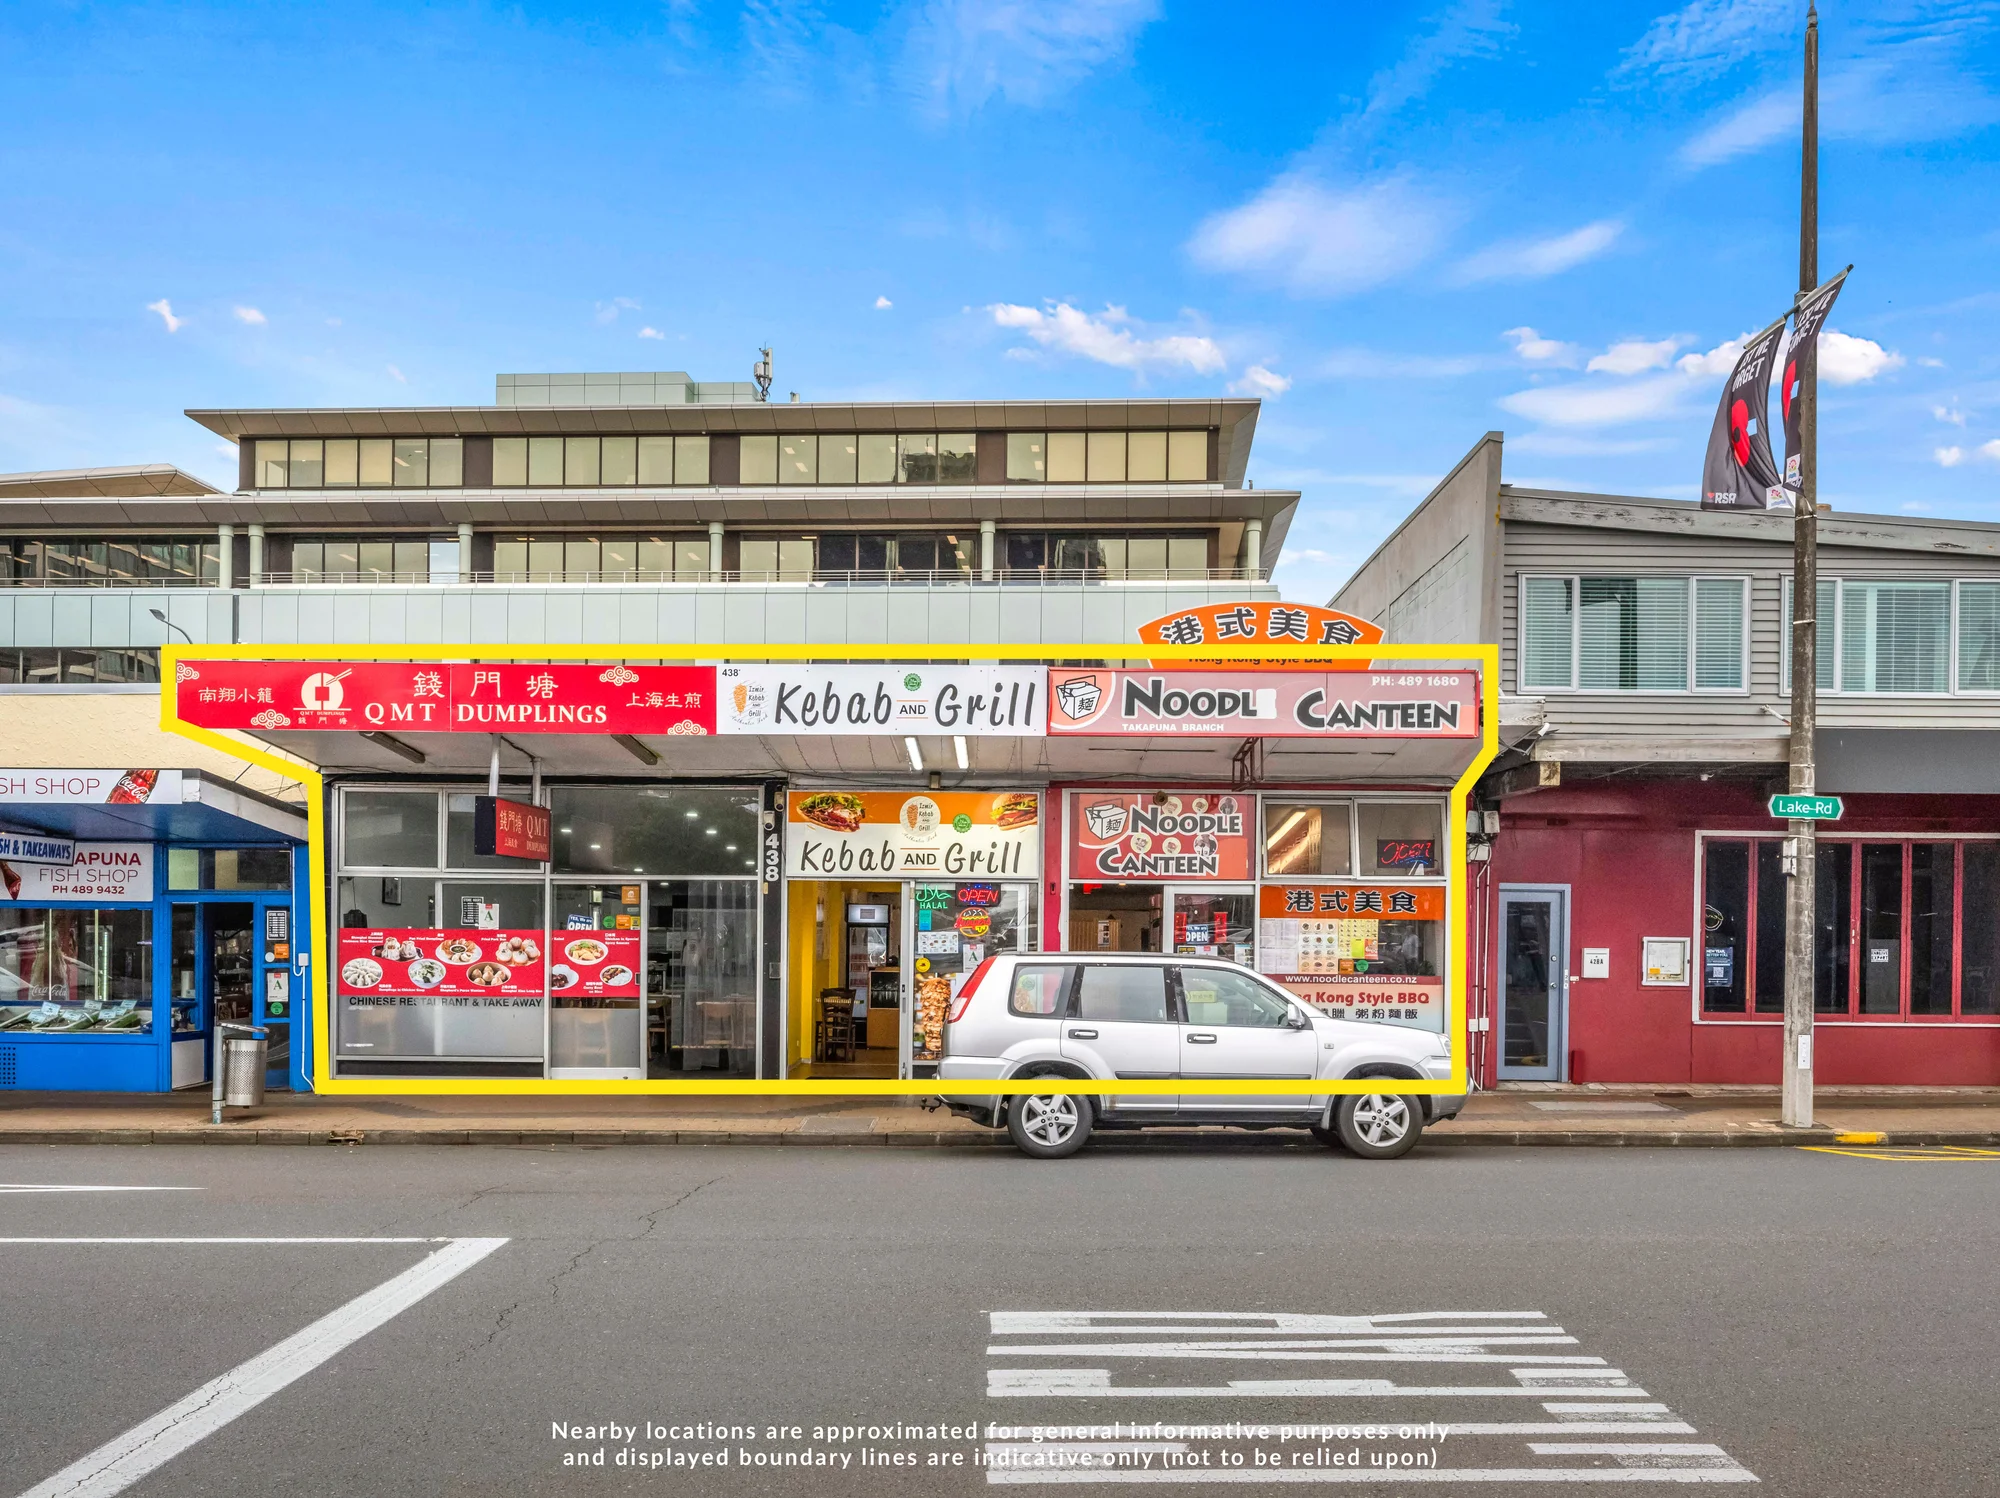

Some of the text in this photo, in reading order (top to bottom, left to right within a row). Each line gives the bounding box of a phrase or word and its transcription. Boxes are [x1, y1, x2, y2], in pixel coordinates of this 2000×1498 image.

[1714, 492, 1737, 504] RSA
[413, 670, 559, 699] 錢門塘
[1372, 676, 1460, 687] PH: 489 1680
[626, 692, 702, 709] 上海生煎
[774, 681, 1036, 727] Kebab AND Grill
[365, 702, 607, 725] QMT DUMPLINGS
[1296, 690, 1459, 730] CANTEEN
[1122, 723, 1224, 732] TAKAPUNA BRANCH
[35, 778, 101, 795] SHOP
[1779, 800, 1833, 815] Lake Rd
[526, 815, 548, 839] QMT
[1130, 806, 1241, 834] NOODLE
[13, 840, 20, 856] &
[22, 841, 72, 860] TAKEAWAYS
[800, 840, 1022, 874] Kebab AND Grill
[765, 833, 780, 883] 438
[1098, 847, 1217, 874] CANTEEN
[39, 868, 139, 883] FISH SHOP
[52, 885, 125, 895] PH 489 9432
[957, 888, 999, 903] OPEN
[919, 901, 948, 909] HALAL
[1285, 889, 1417, 913] 港式美食
[484, 910, 494, 921] A
[1186, 932, 1208, 942] OPEN
[968, 951, 979, 962] A
[273, 979, 283, 990] A
[1285, 975, 1418, 984] www.noodlecanteen.co.nz
[349, 996, 543, 1008] CHINESE RESTARANT & TAKE AWAY
[1316, 992, 1354, 1006] Kong
[1361, 992, 1394, 1007] Style
[1397, 992, 1430, 1004] BBQ
